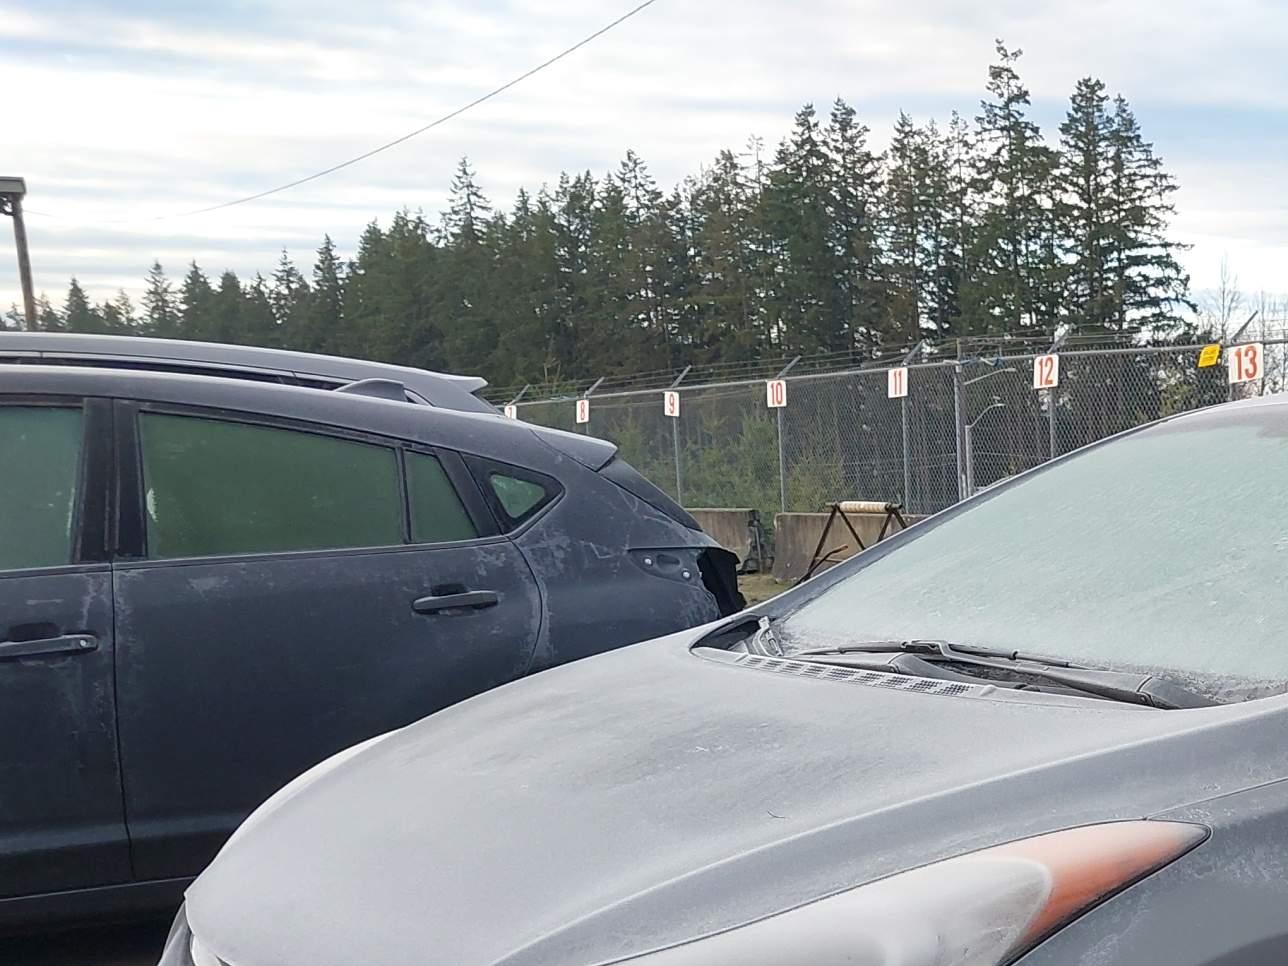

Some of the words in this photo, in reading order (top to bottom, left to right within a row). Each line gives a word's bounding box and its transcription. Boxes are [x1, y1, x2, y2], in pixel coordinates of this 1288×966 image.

[1038, 356, 1054, 386] 12
[1234, 345, 1258, 380] 13
[770, 381, 783, 406] 10
[893, 369, 904, 396] 11
[580, 401, 586, 421] 8
[668, 393, 676, 415] 9
